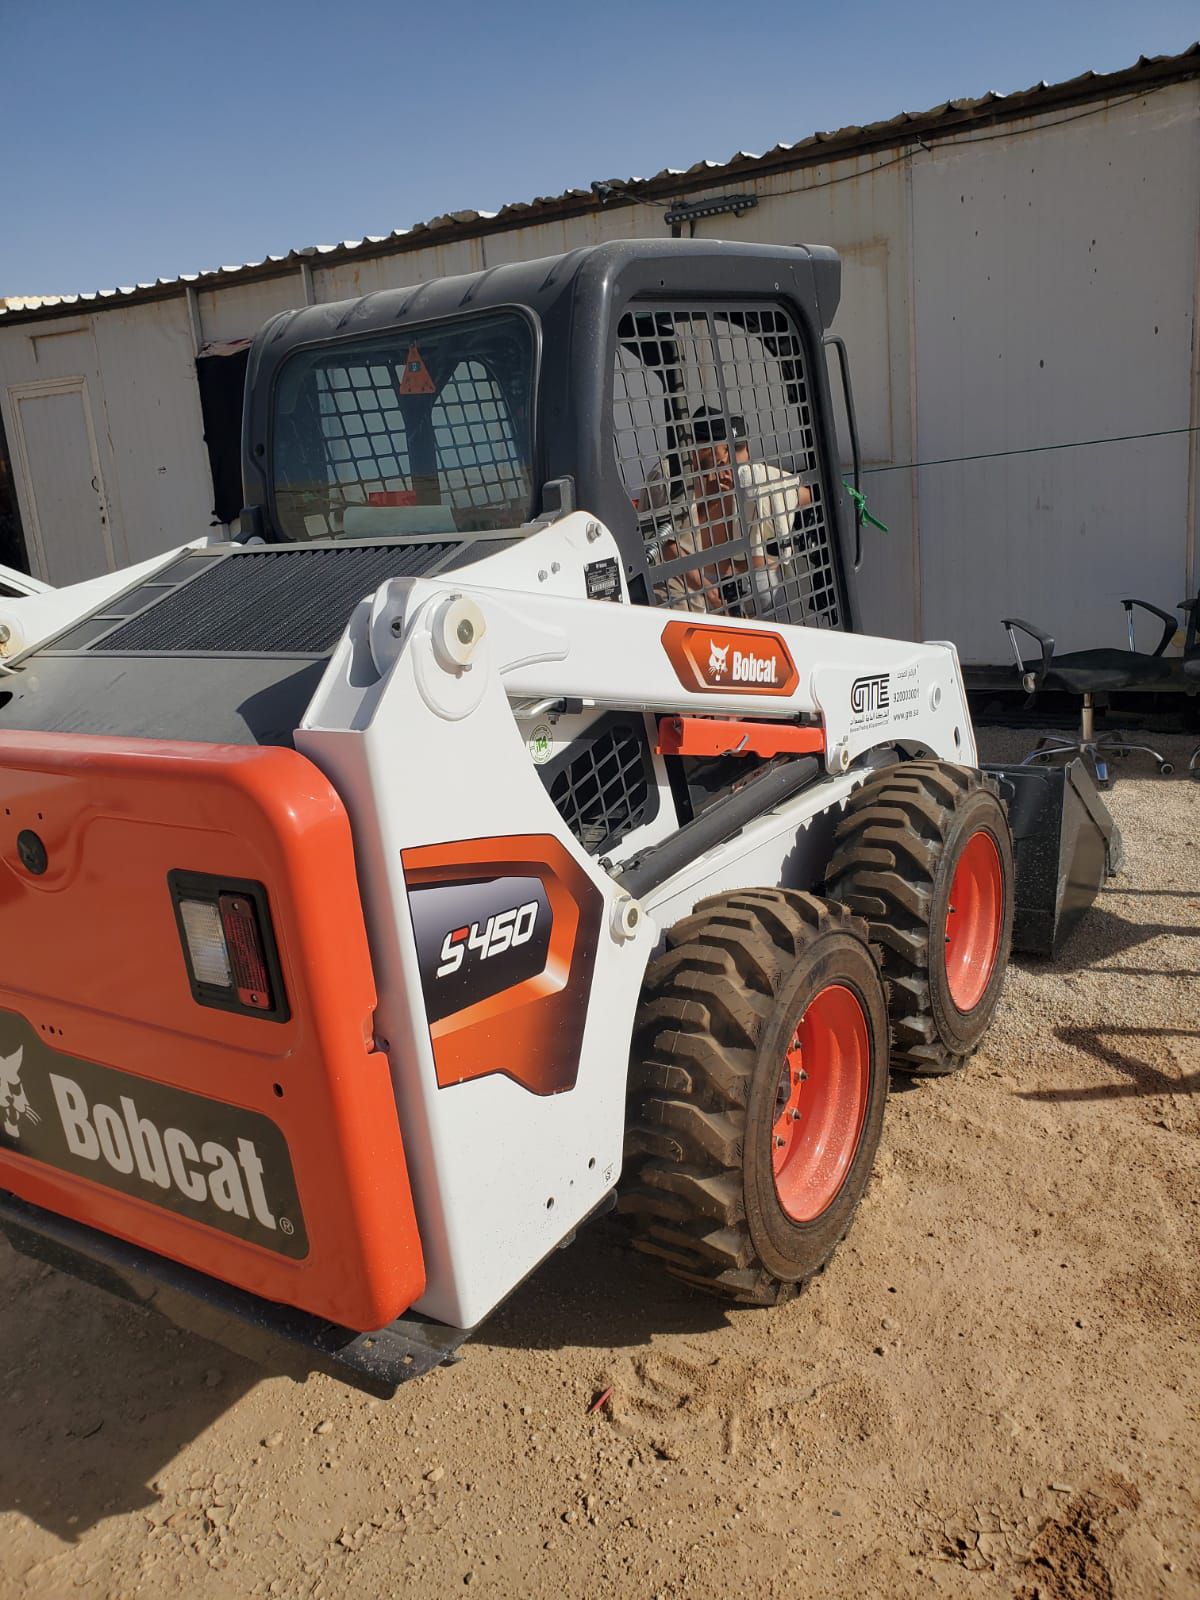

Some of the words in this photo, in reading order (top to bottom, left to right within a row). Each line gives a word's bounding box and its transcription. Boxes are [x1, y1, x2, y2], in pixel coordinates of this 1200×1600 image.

[732, 651, 777, 683] Bobcat
[437, 901, 539, 978] S450
[49, 1072, 277, 1230] Bobcat
